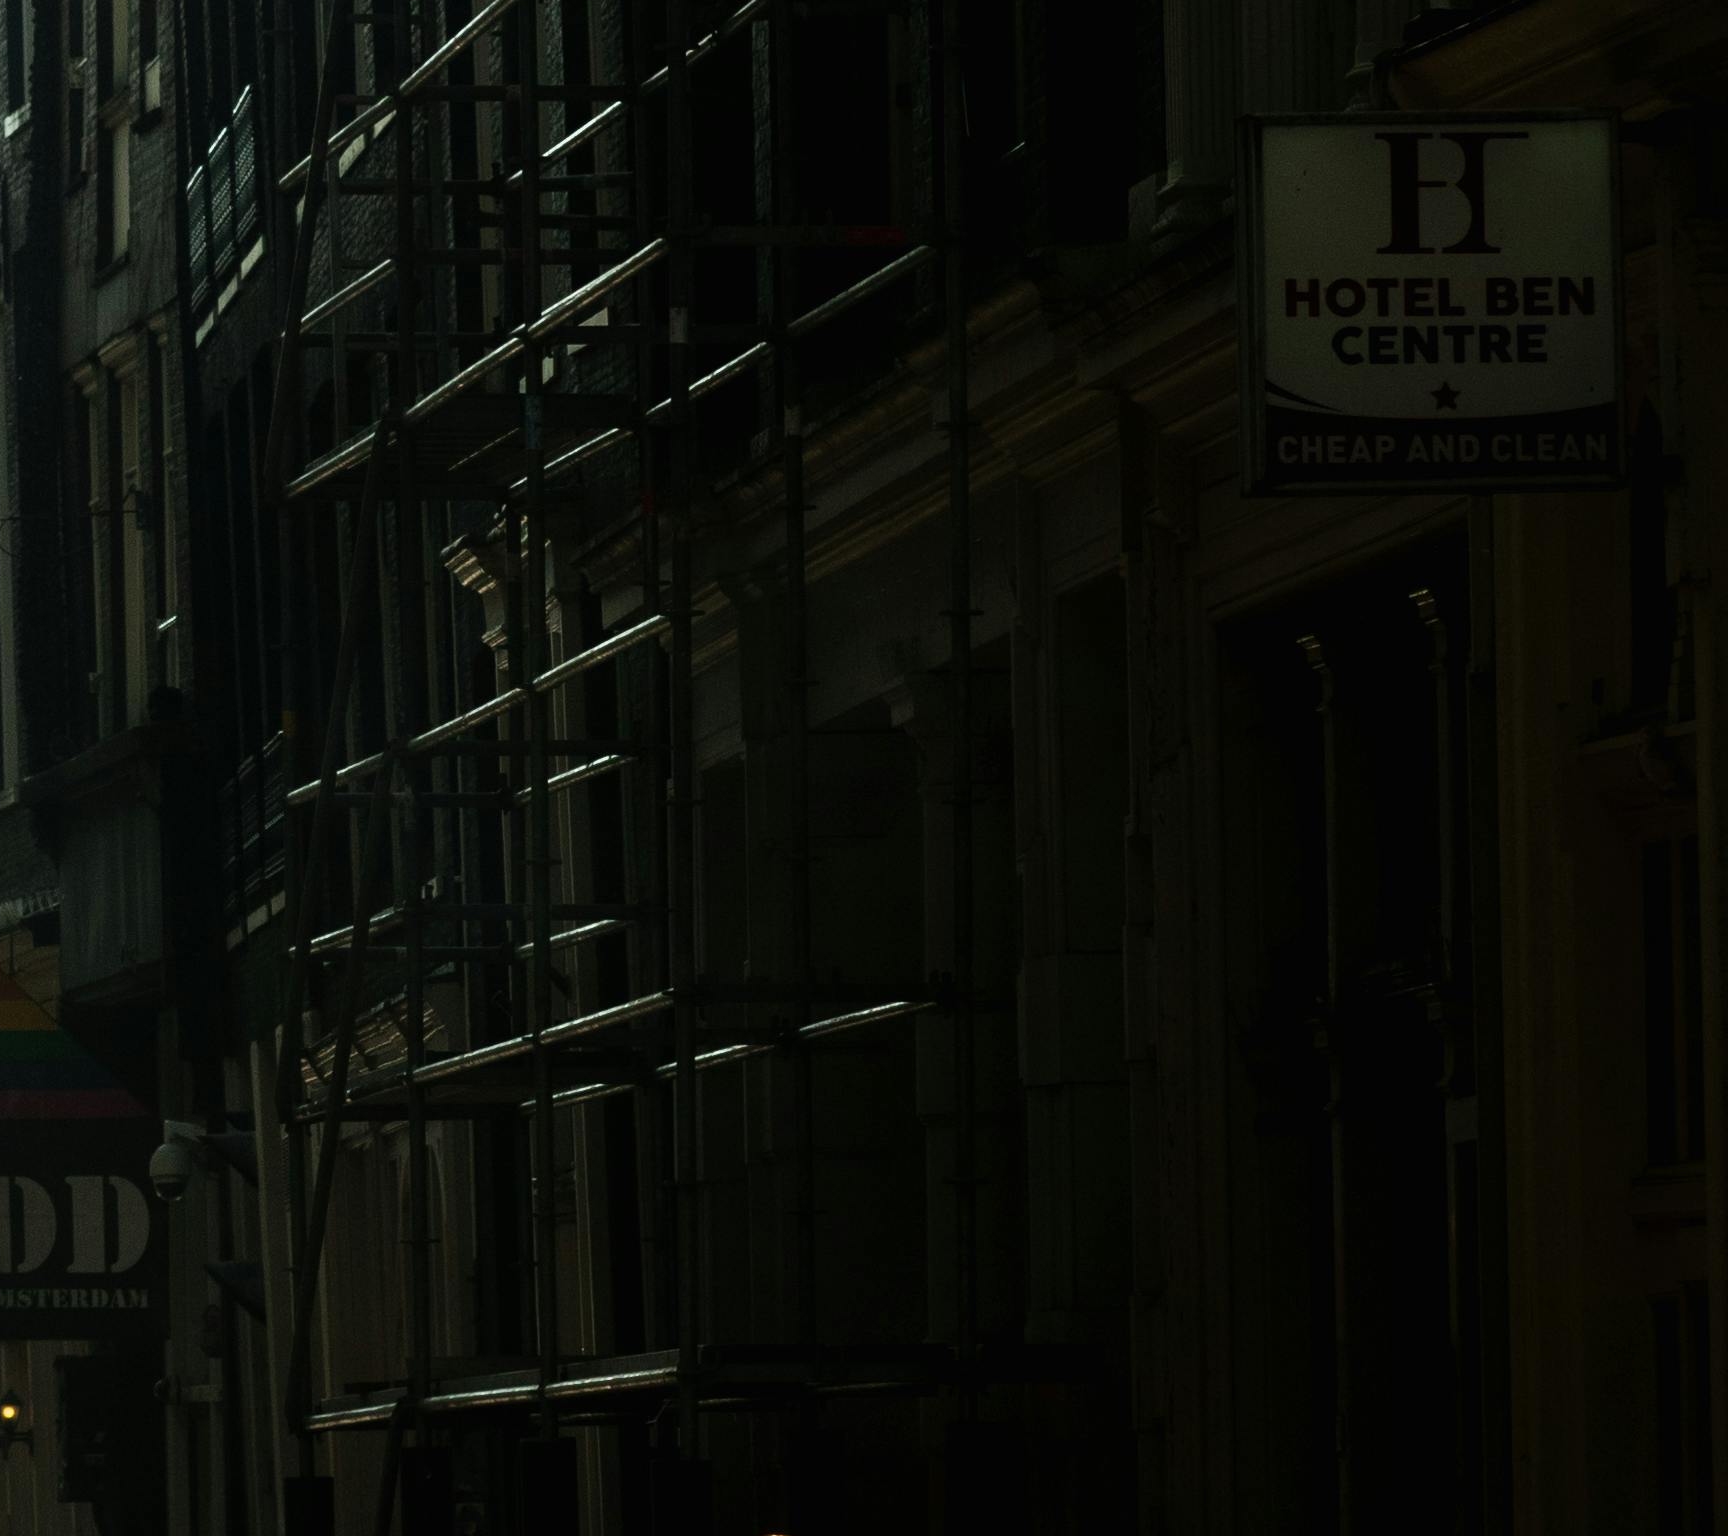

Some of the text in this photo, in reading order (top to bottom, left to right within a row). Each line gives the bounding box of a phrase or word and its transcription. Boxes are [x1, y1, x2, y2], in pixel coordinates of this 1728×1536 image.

[1285, 277, 1595, 316] HOTEL BEN
[1331, 325, 1548, 365] CENTRE
[1276, 431, 1609, 464] CHEAP AND CLEAN
